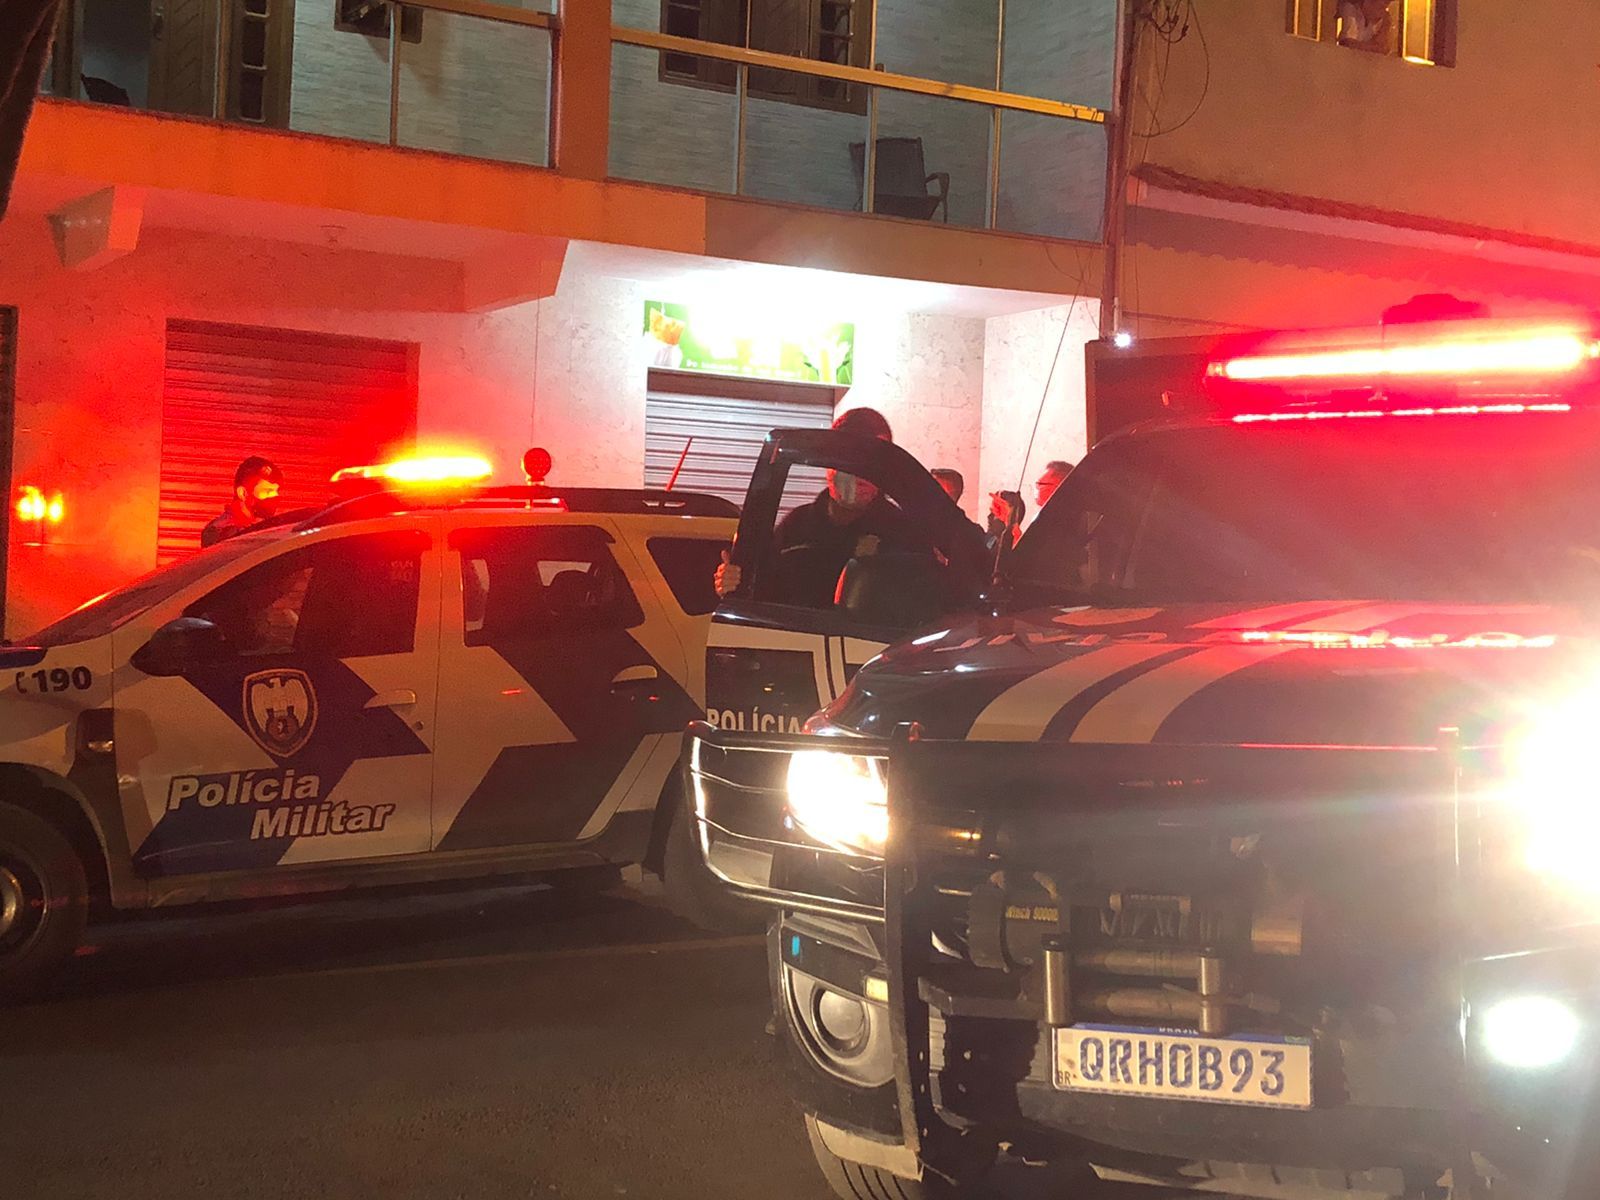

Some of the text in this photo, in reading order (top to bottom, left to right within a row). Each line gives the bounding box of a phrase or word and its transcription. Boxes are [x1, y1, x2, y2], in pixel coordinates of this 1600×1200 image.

[31, 665, 92, 693] 190
[706, 705, 801, 734] POLÍCIA
[168, 768, 320, 811] Polícia
[250, 801, 395, 840] Militar
